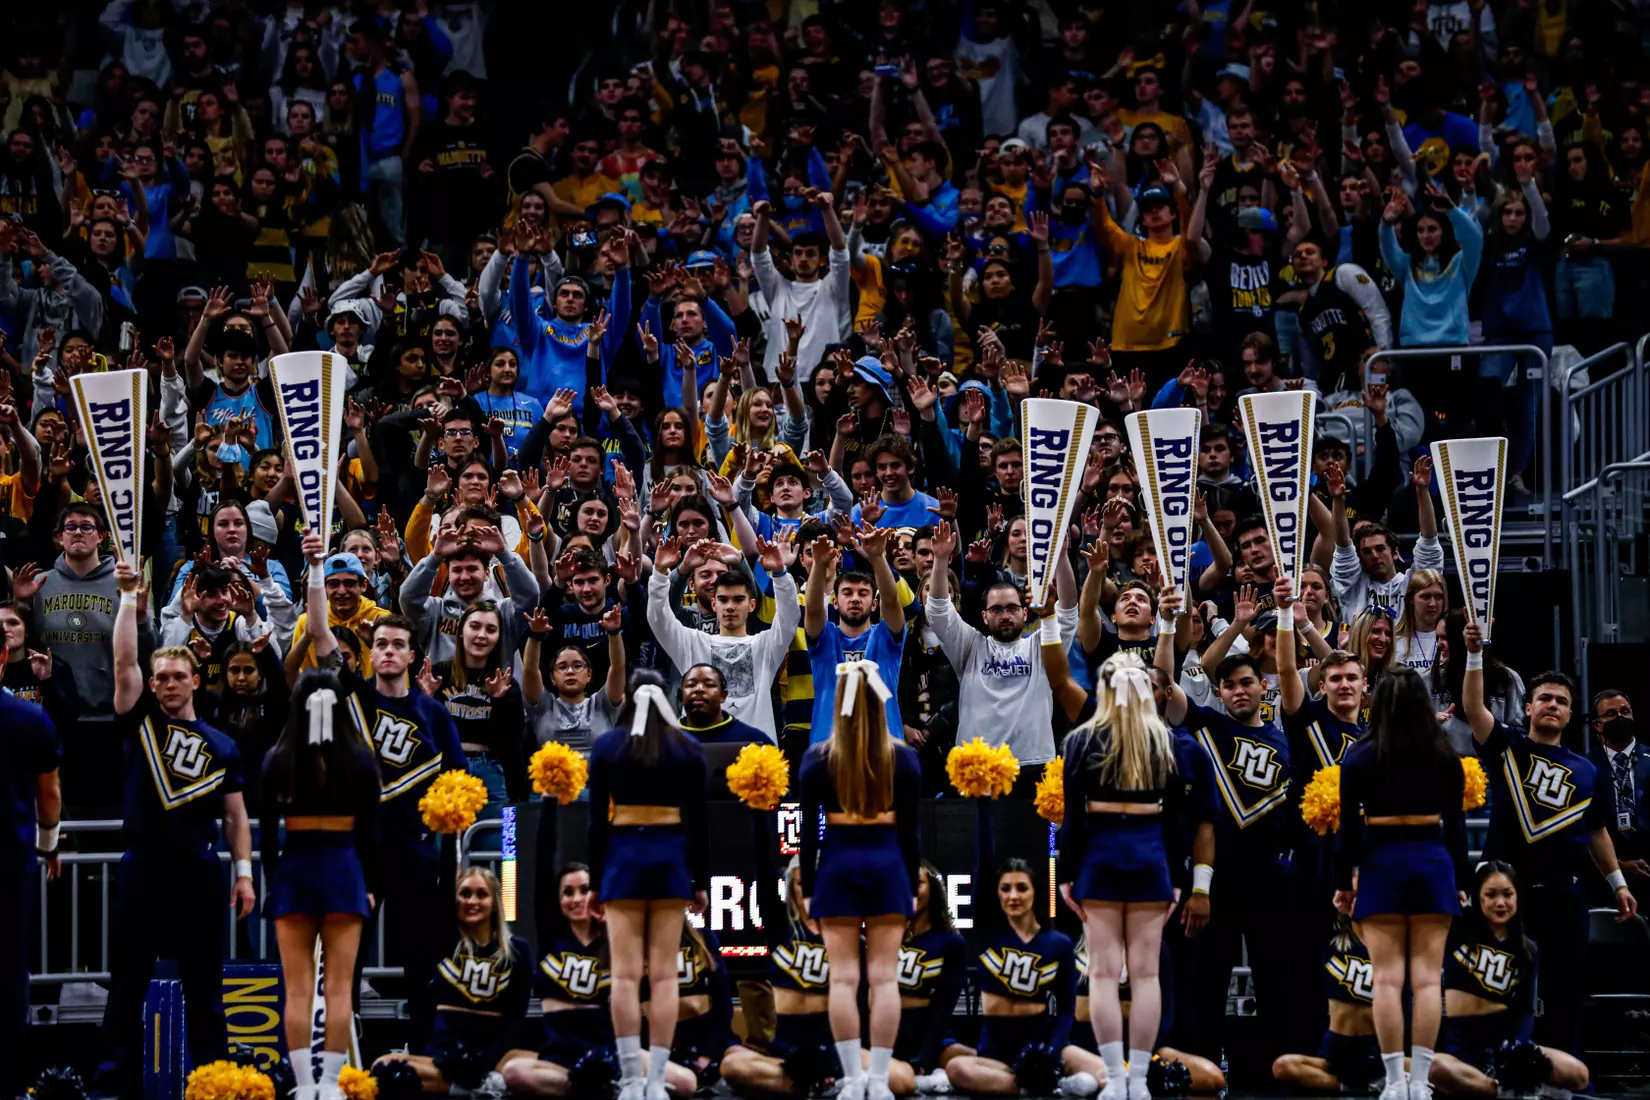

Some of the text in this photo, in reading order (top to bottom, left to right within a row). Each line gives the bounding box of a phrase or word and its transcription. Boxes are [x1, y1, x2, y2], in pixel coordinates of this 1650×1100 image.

[89, 398, 134, 554] RING OUT
[281, 379, 322, 535] RING OUT
[1030, 427, 1070, 586] RING OUT
[1154, 436, 1192, 592] RING OUT
[1258, 419, 1300, 578] RING OUT
[1454, 468, 1496, 623] RING OUT
[43, 593, 113, 615] MARQUETTE
[44, 631, 107, 644] UNIVERSITY
[162, 728, 206, 780] MU
[371, 714, 413, 767] MU
[1232, 739, 1275, 789] MU
[1525, 758, 1569, 809] MU
[460, 957, 497, 998] MU
[559, 953, 598, 996] MU
[792, 943, 829, 985] MU
[1001, 949, 1040, 994] MU
[1475, 948, 1513, 993] MU
